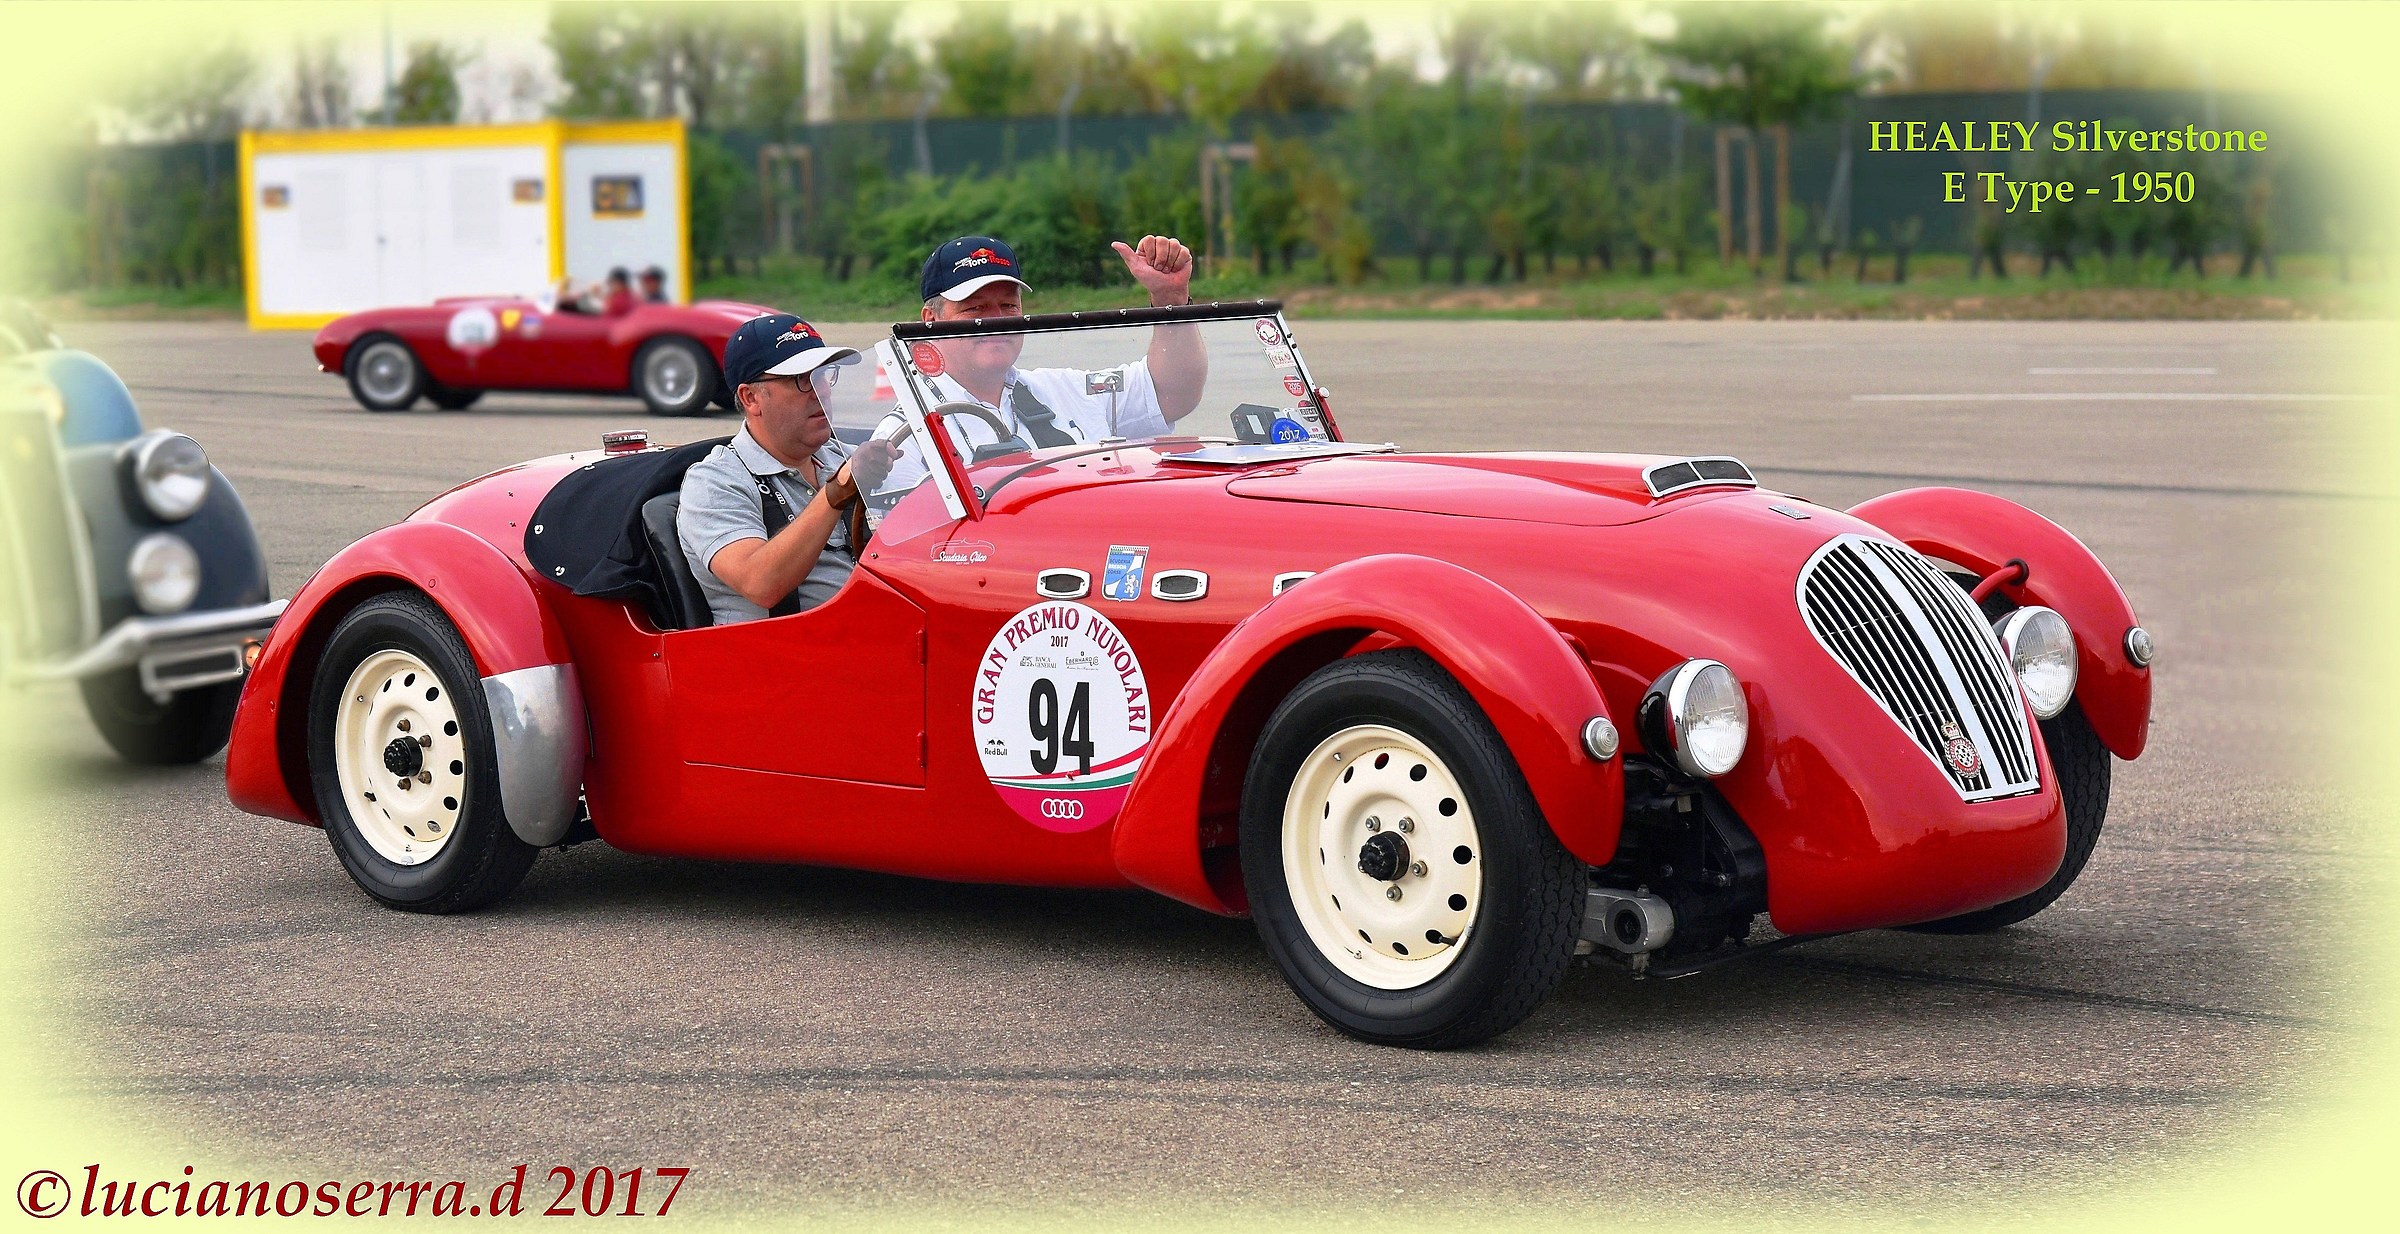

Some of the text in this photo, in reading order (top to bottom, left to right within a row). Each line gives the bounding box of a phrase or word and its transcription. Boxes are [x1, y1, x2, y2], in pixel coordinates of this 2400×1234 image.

[1278, 429, 1300, 441] 2017
[1050, 635, 1069, 648] 2017
[977, 606, 1147, 734] GRAN PREMIO NUVOLARI
[1028, 677, 1095, 776] 94
[984, 747, 1008, 756] Red Bull
